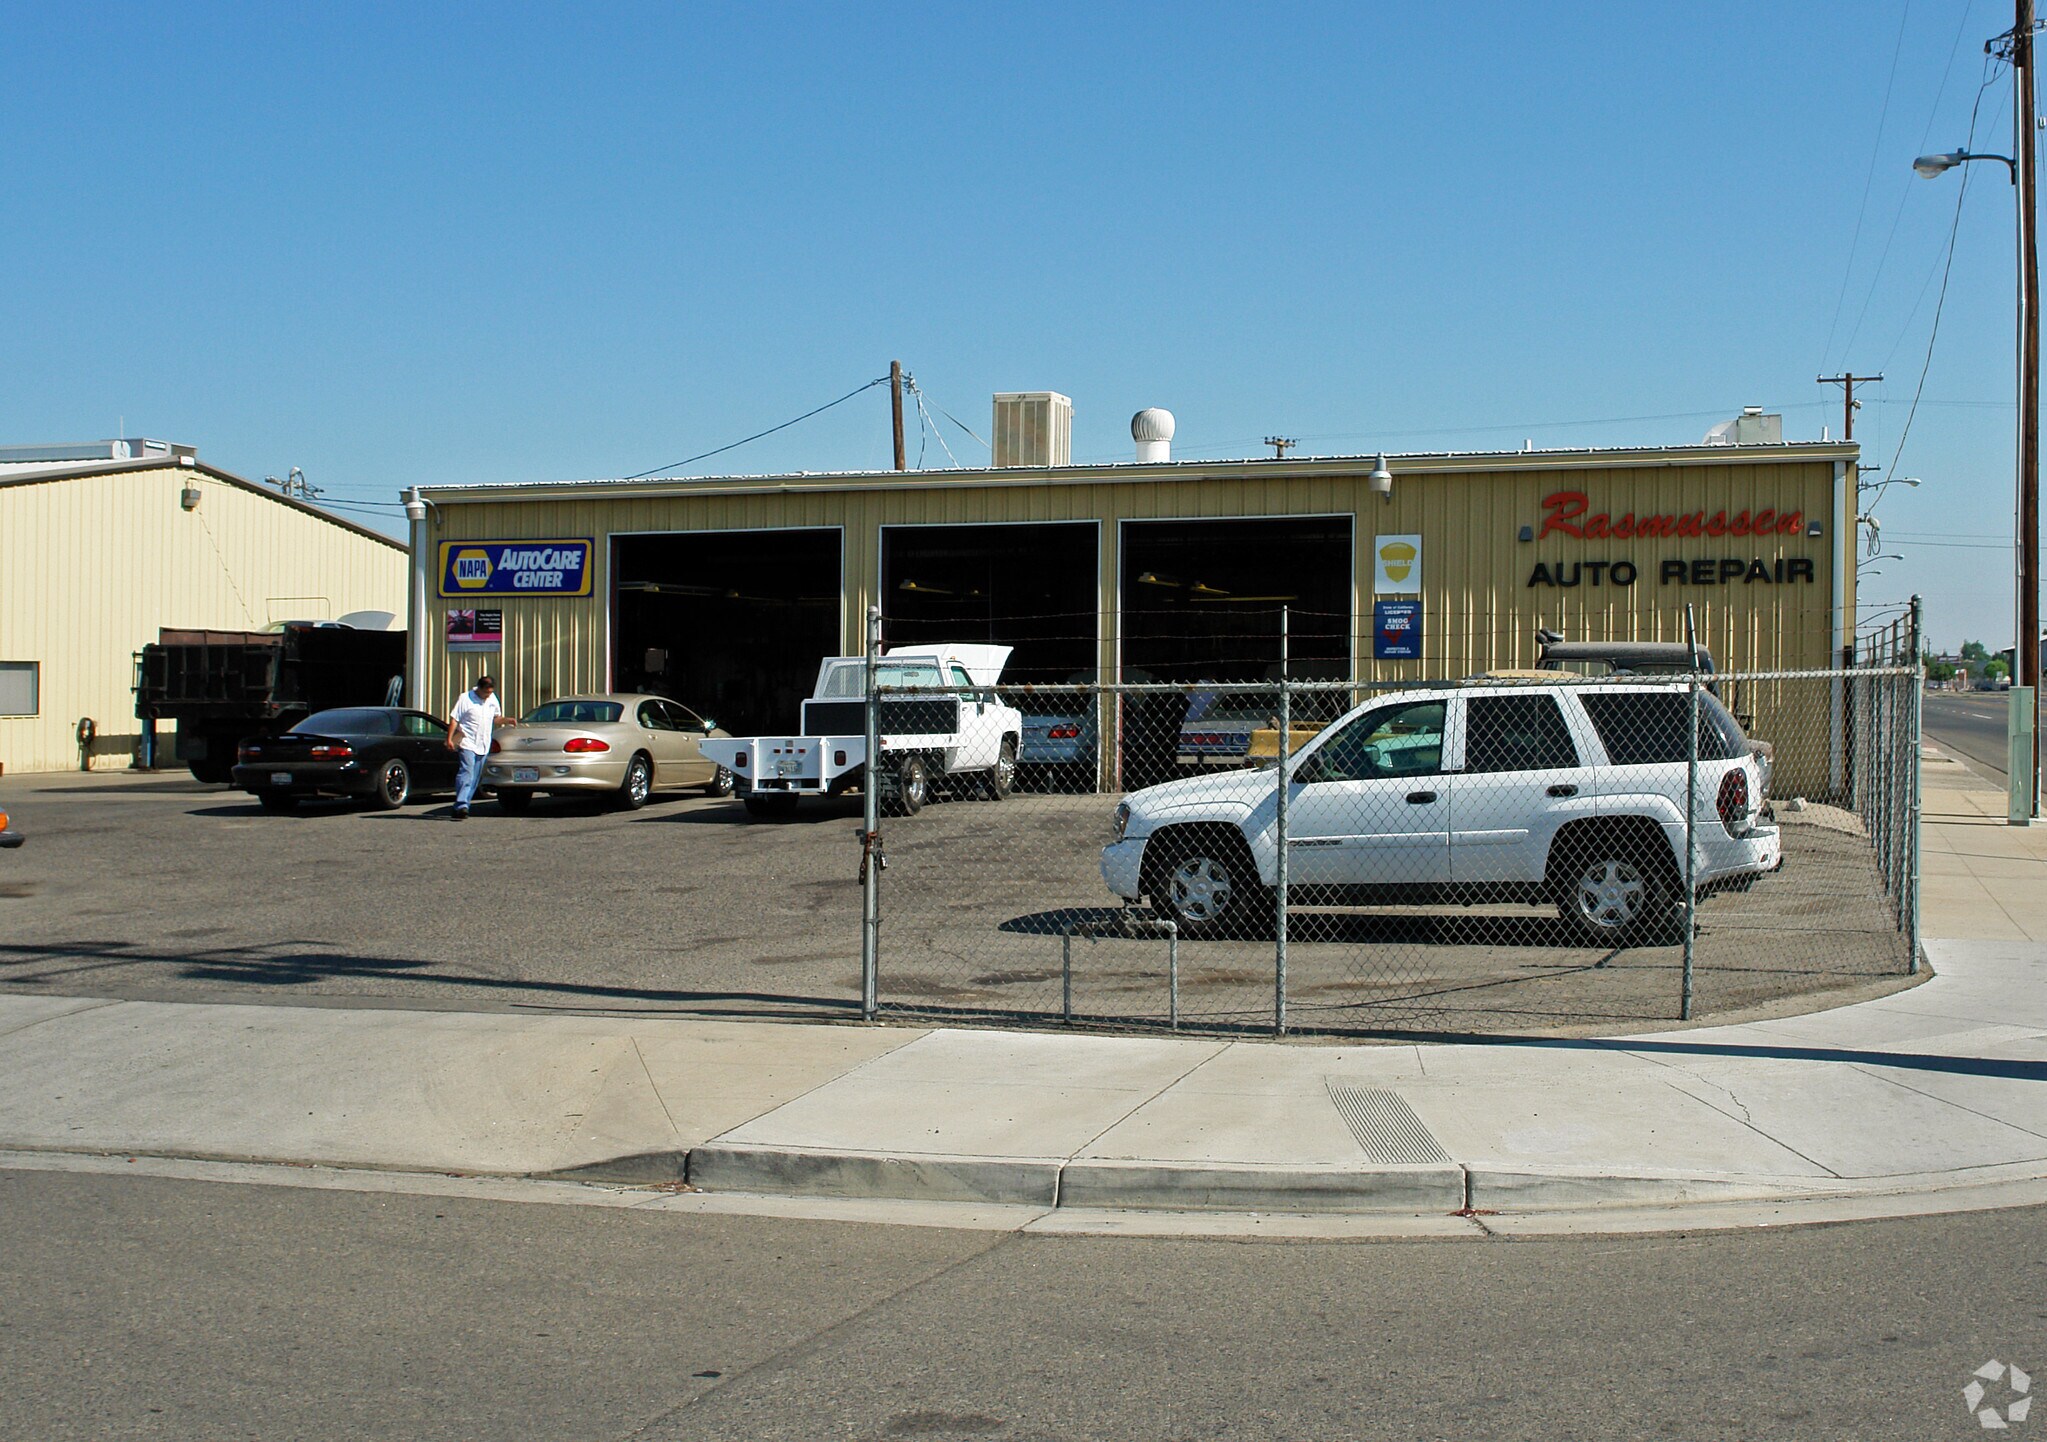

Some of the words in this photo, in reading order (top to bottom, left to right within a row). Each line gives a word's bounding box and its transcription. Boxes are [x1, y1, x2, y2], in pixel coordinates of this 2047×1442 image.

[1538, 491, 1804, 539] Rasmussen
[459, 559, 487, 578] NAPA
[497, 548, 582, 570] AUTOCARE
[513, 570, 563, 588] CENTER
[1527, 561, 1638, 587] AUTO
[1660, 558, 1814, 585] REPAIR
